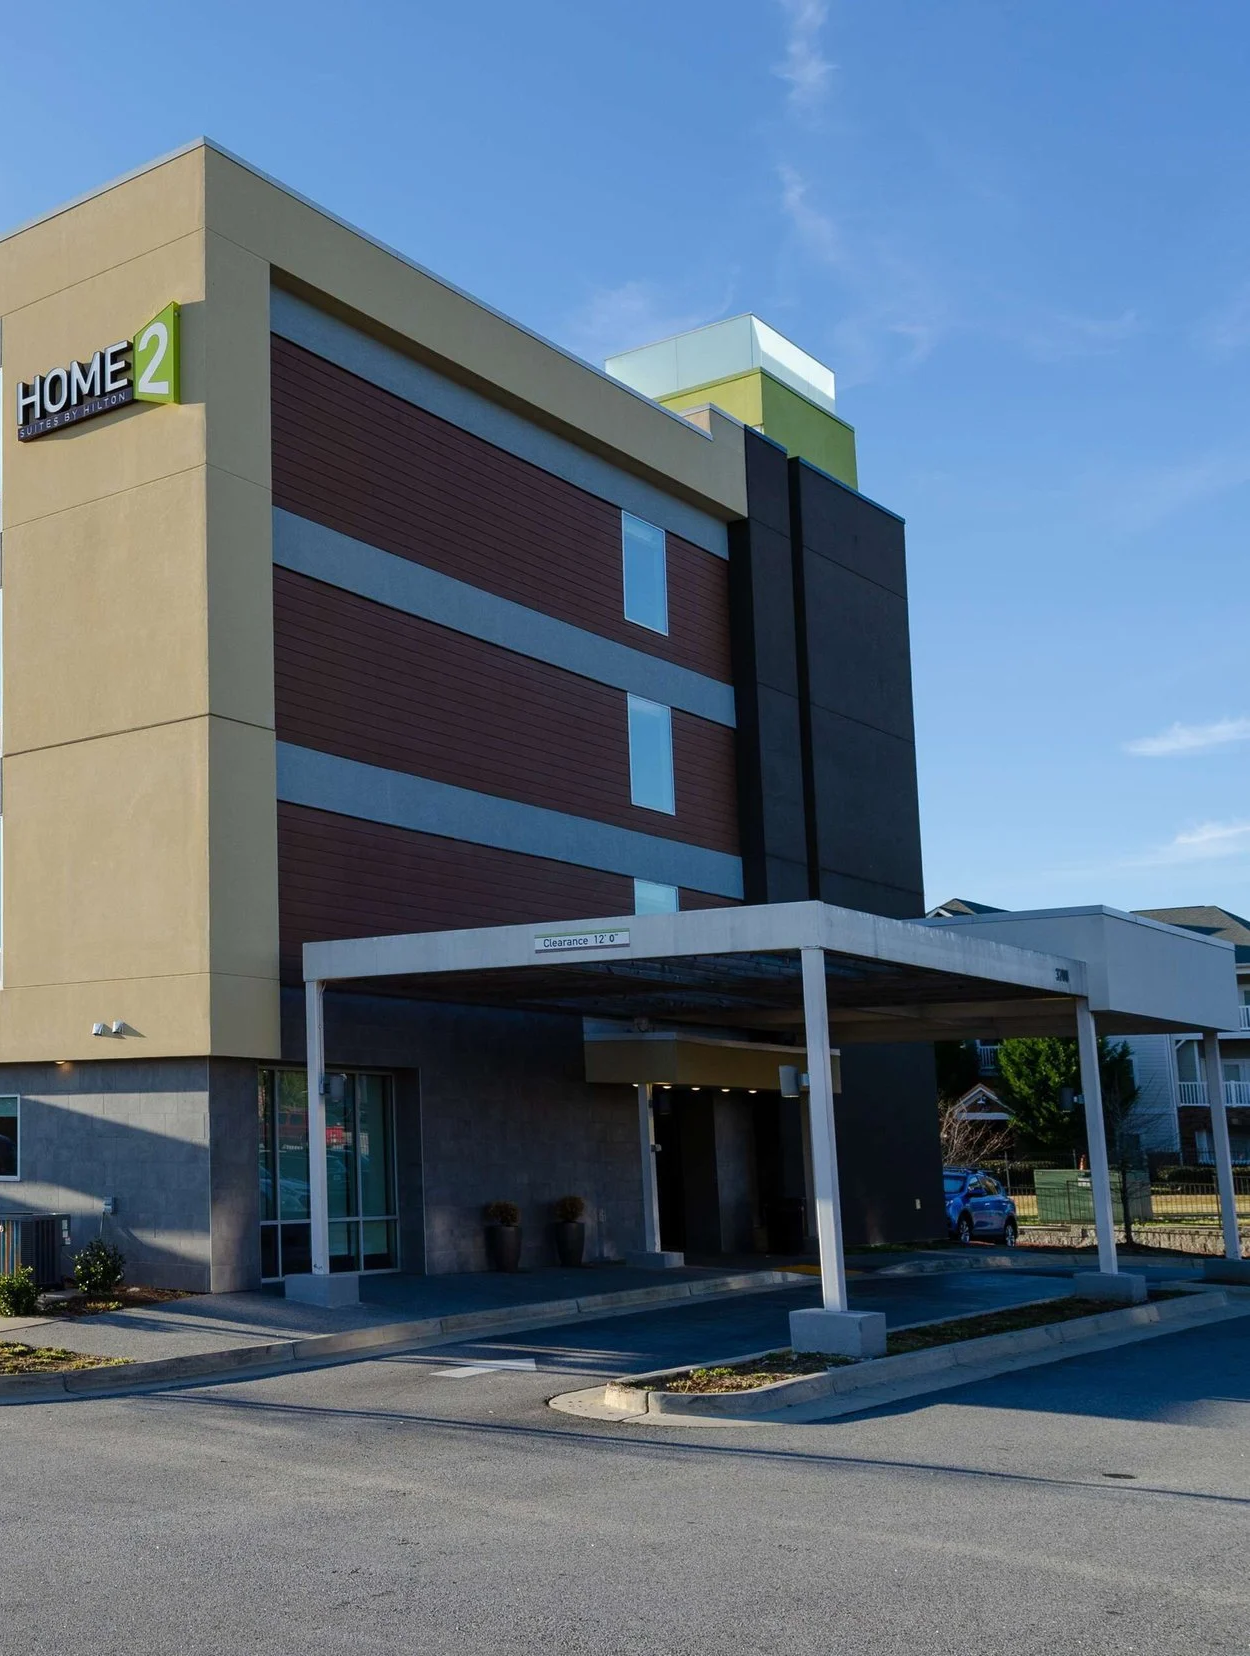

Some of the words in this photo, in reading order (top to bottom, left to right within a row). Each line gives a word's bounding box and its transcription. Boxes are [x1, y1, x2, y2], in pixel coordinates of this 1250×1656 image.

[17, 340, 128, 426] HOME
[138, 322, 169, 395] 2
[19, 418, 60, 438] SUITES
[64, 410, 78, 422] BY
[83, 391, 126, 415] HILTON
[543, 937, 589, 948] Clearance
[594, 934, 607, 944] 12'
